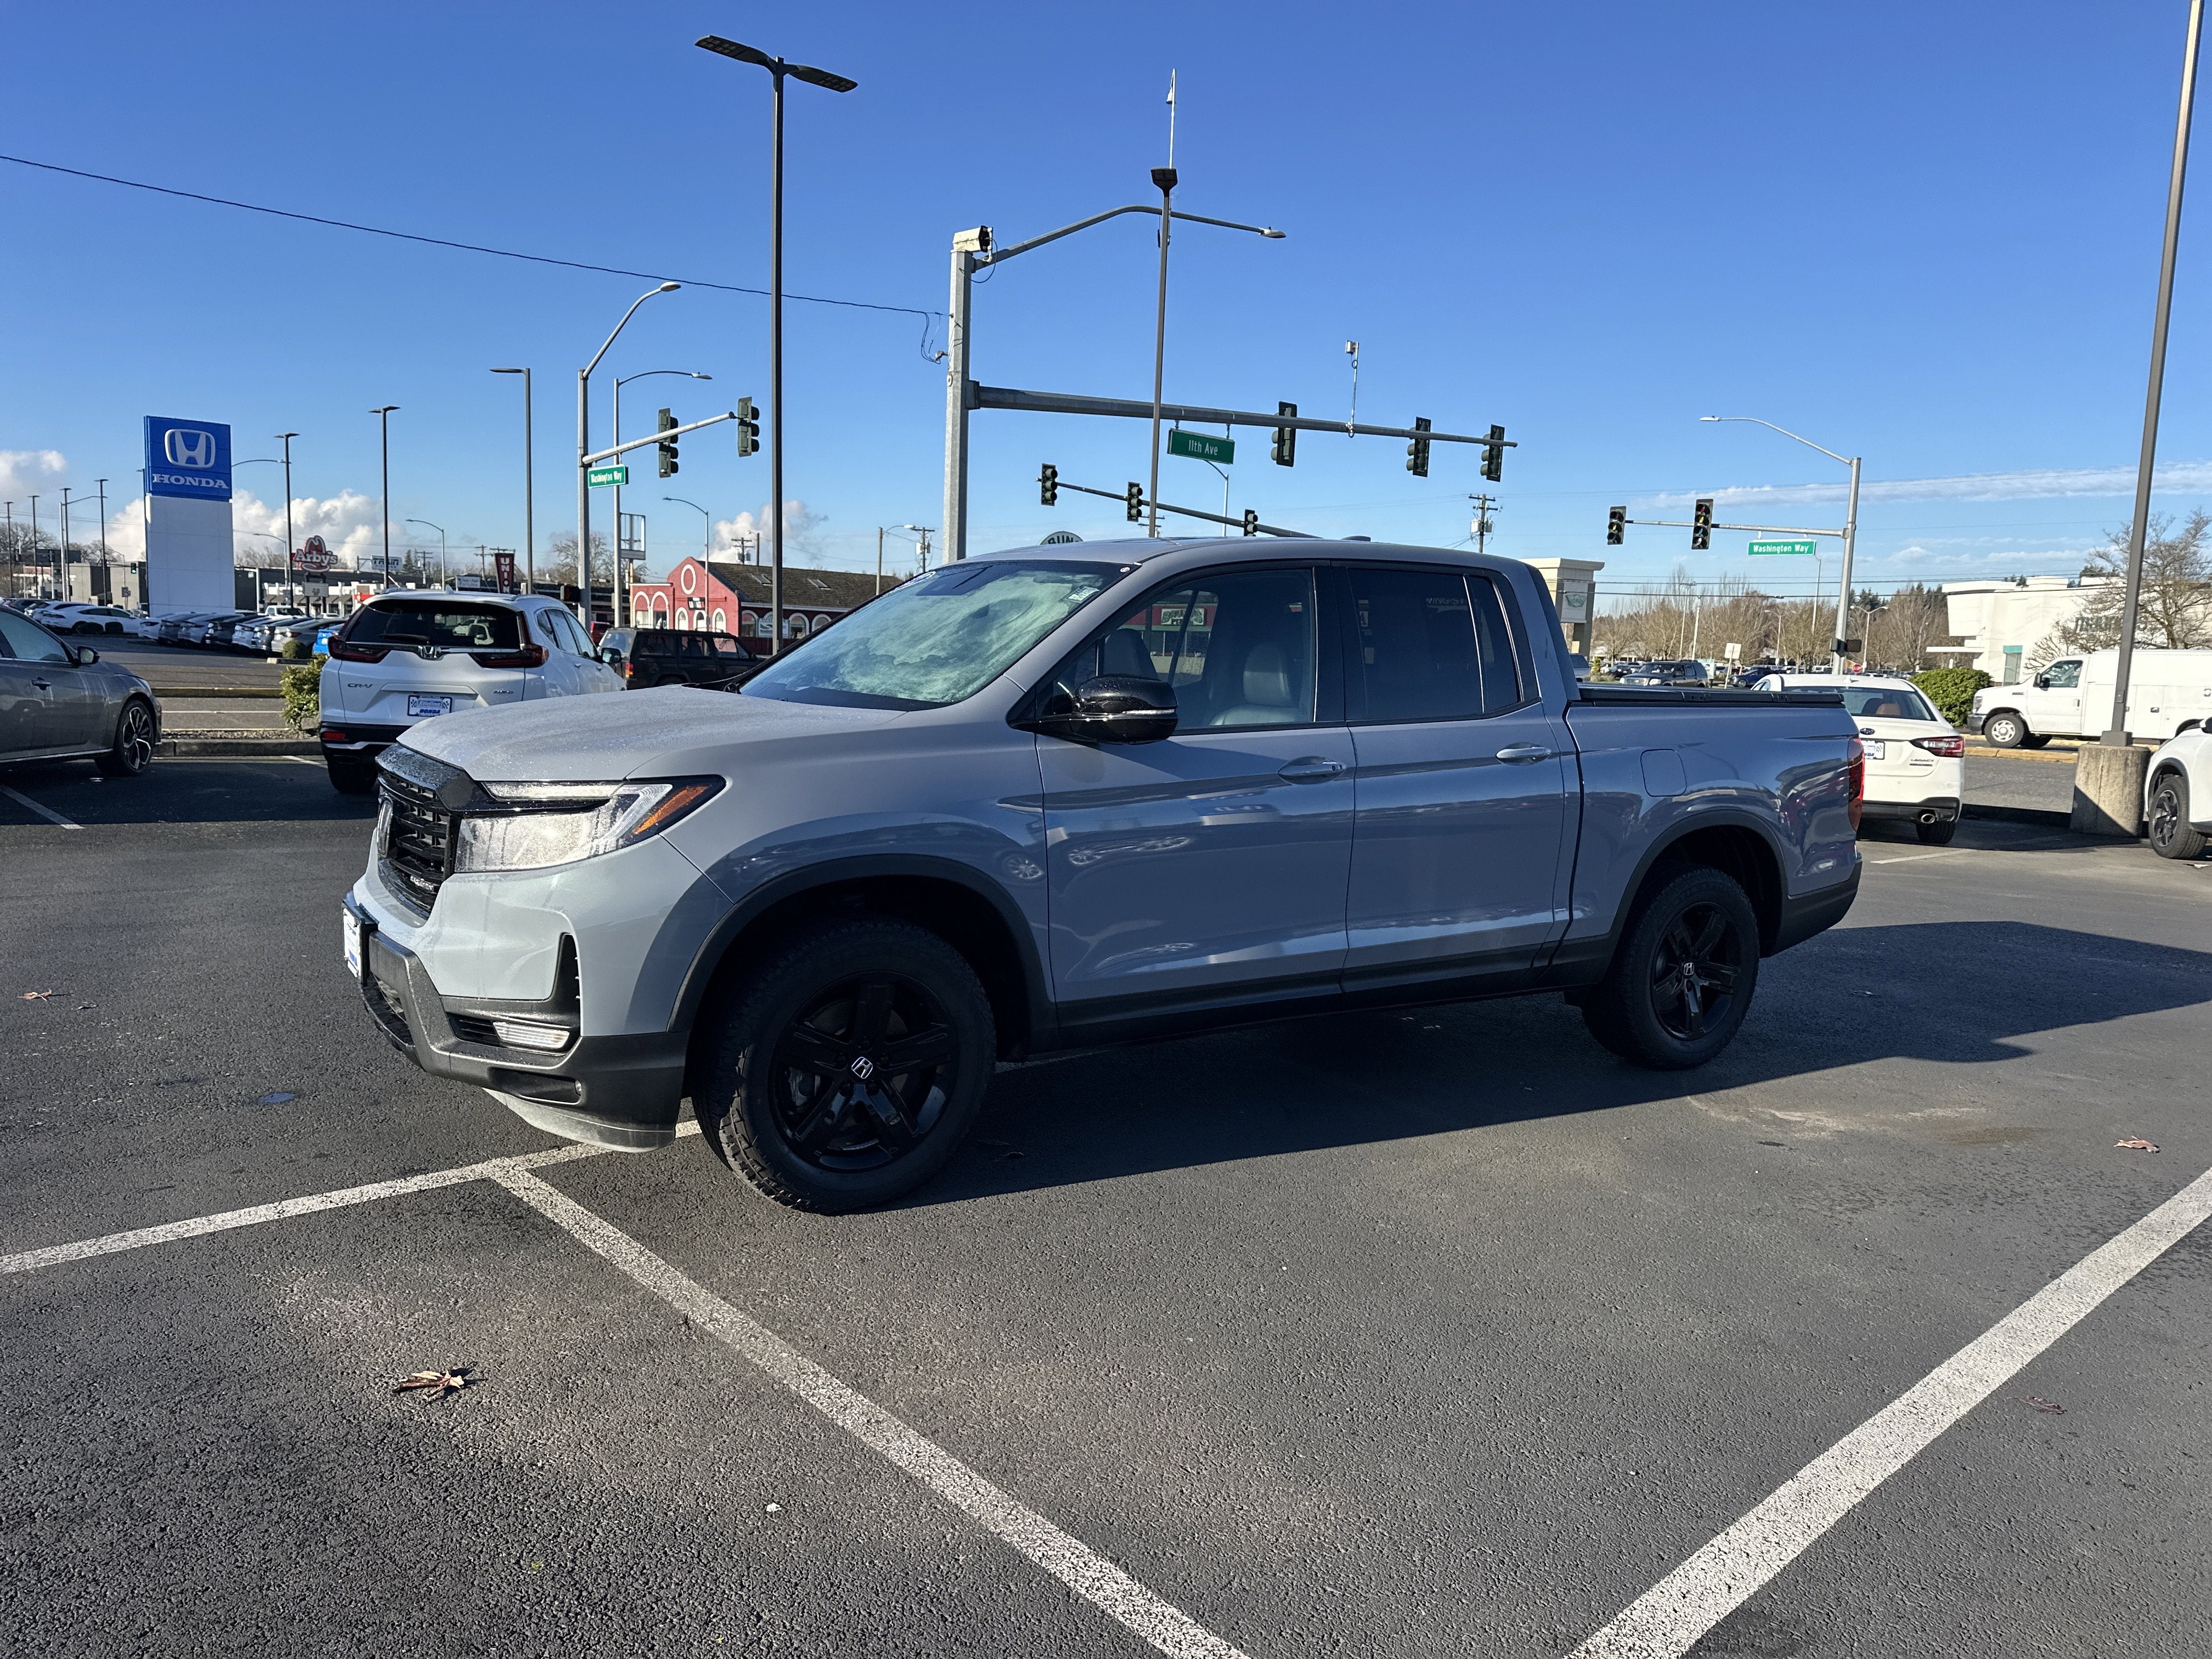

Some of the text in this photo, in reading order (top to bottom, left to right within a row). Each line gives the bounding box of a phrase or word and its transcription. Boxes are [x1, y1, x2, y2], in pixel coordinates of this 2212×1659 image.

[1188, 439, 1218, 456] 11th Ave
[153, 473, 229, 489] HONDA
[591, 471, 622, 484] Washington Way
[1753, 544, 1809, 554] Washington Way
[296, 549, 337, 566] Arby's
